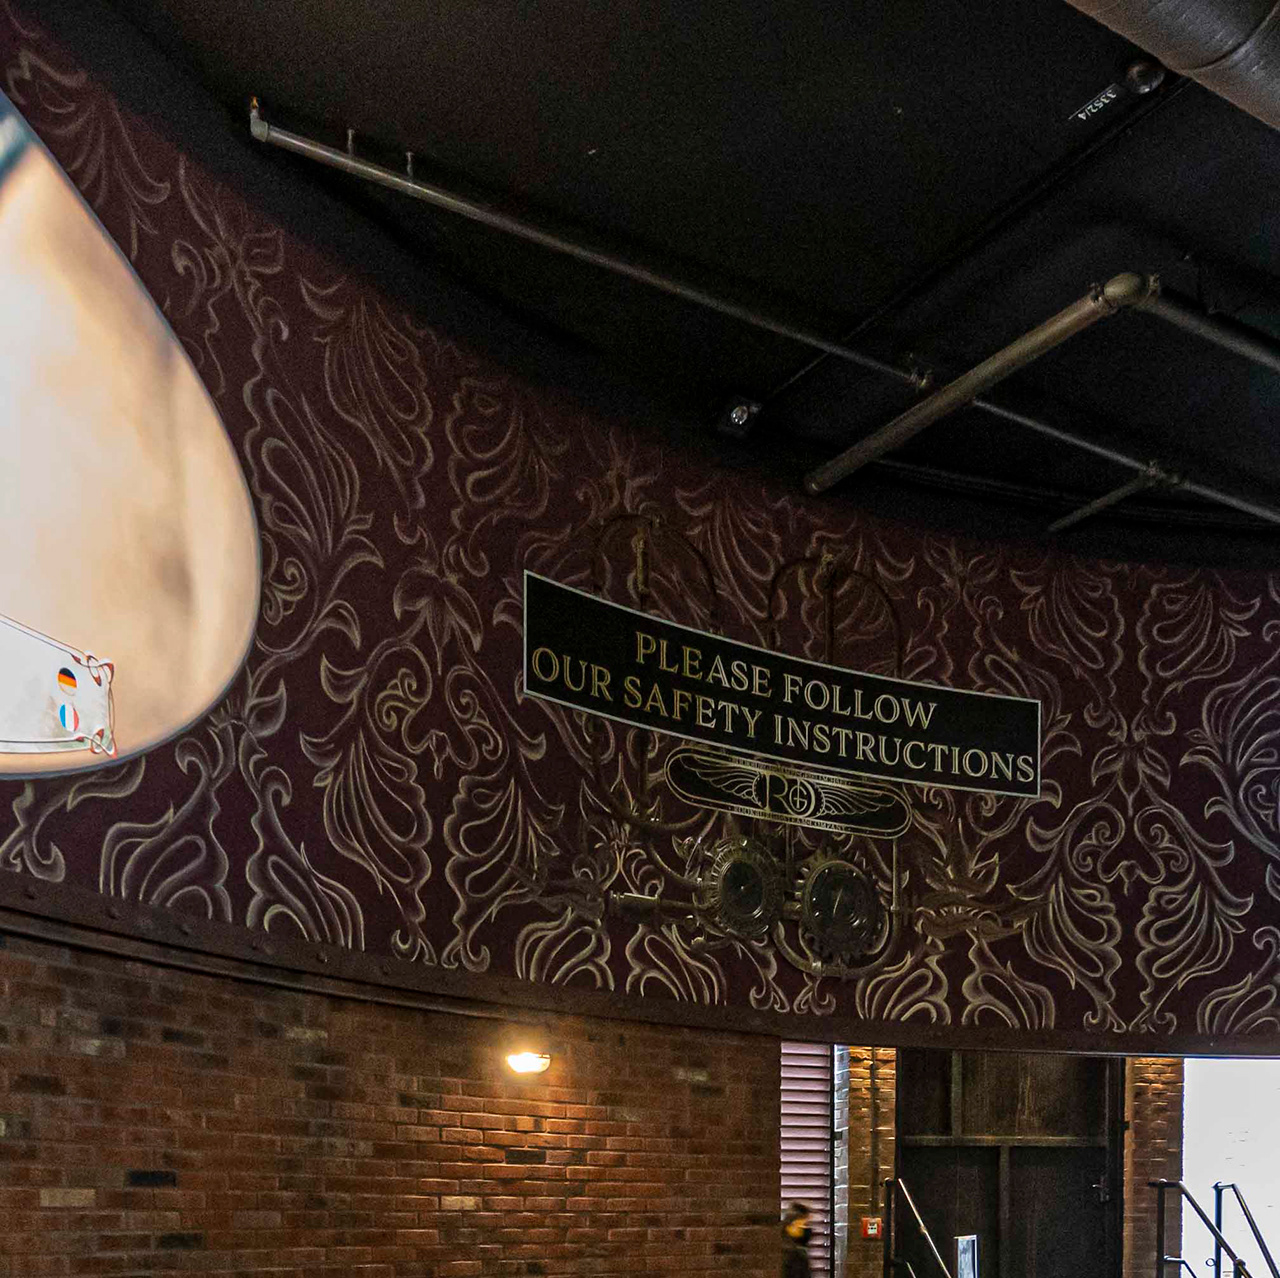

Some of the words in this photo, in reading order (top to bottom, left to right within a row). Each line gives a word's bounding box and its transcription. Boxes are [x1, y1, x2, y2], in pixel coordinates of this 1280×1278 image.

[531, 647, 613, 701] OUR
[623, 675, 762, 738] SAFETY
[773, 714, 1034, 784] INSTRUCTIONS
[634, 631, 772, 699] PLEASE
[783, 674, 938, 730] FOLLOW
